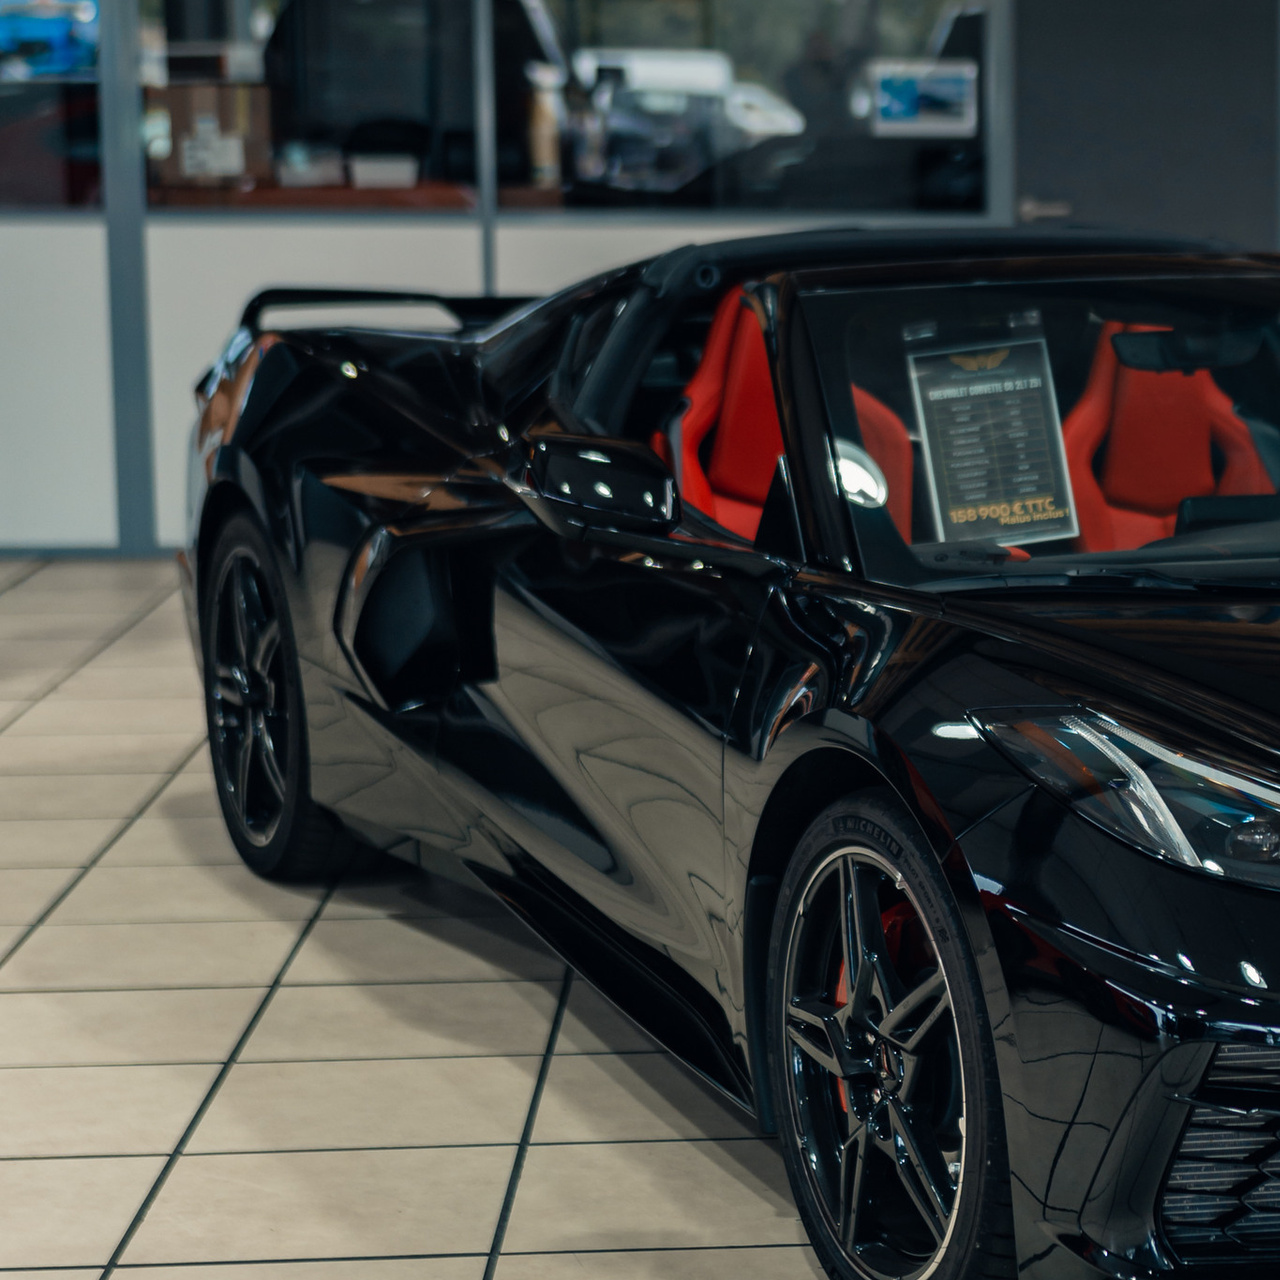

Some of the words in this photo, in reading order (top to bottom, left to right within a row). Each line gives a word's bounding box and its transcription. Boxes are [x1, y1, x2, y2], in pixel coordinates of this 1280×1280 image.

[949, 508, 977, 524] 158
[977, 503, 1011, 519] 900
[846, 817, 900, 856] MICHELIN
